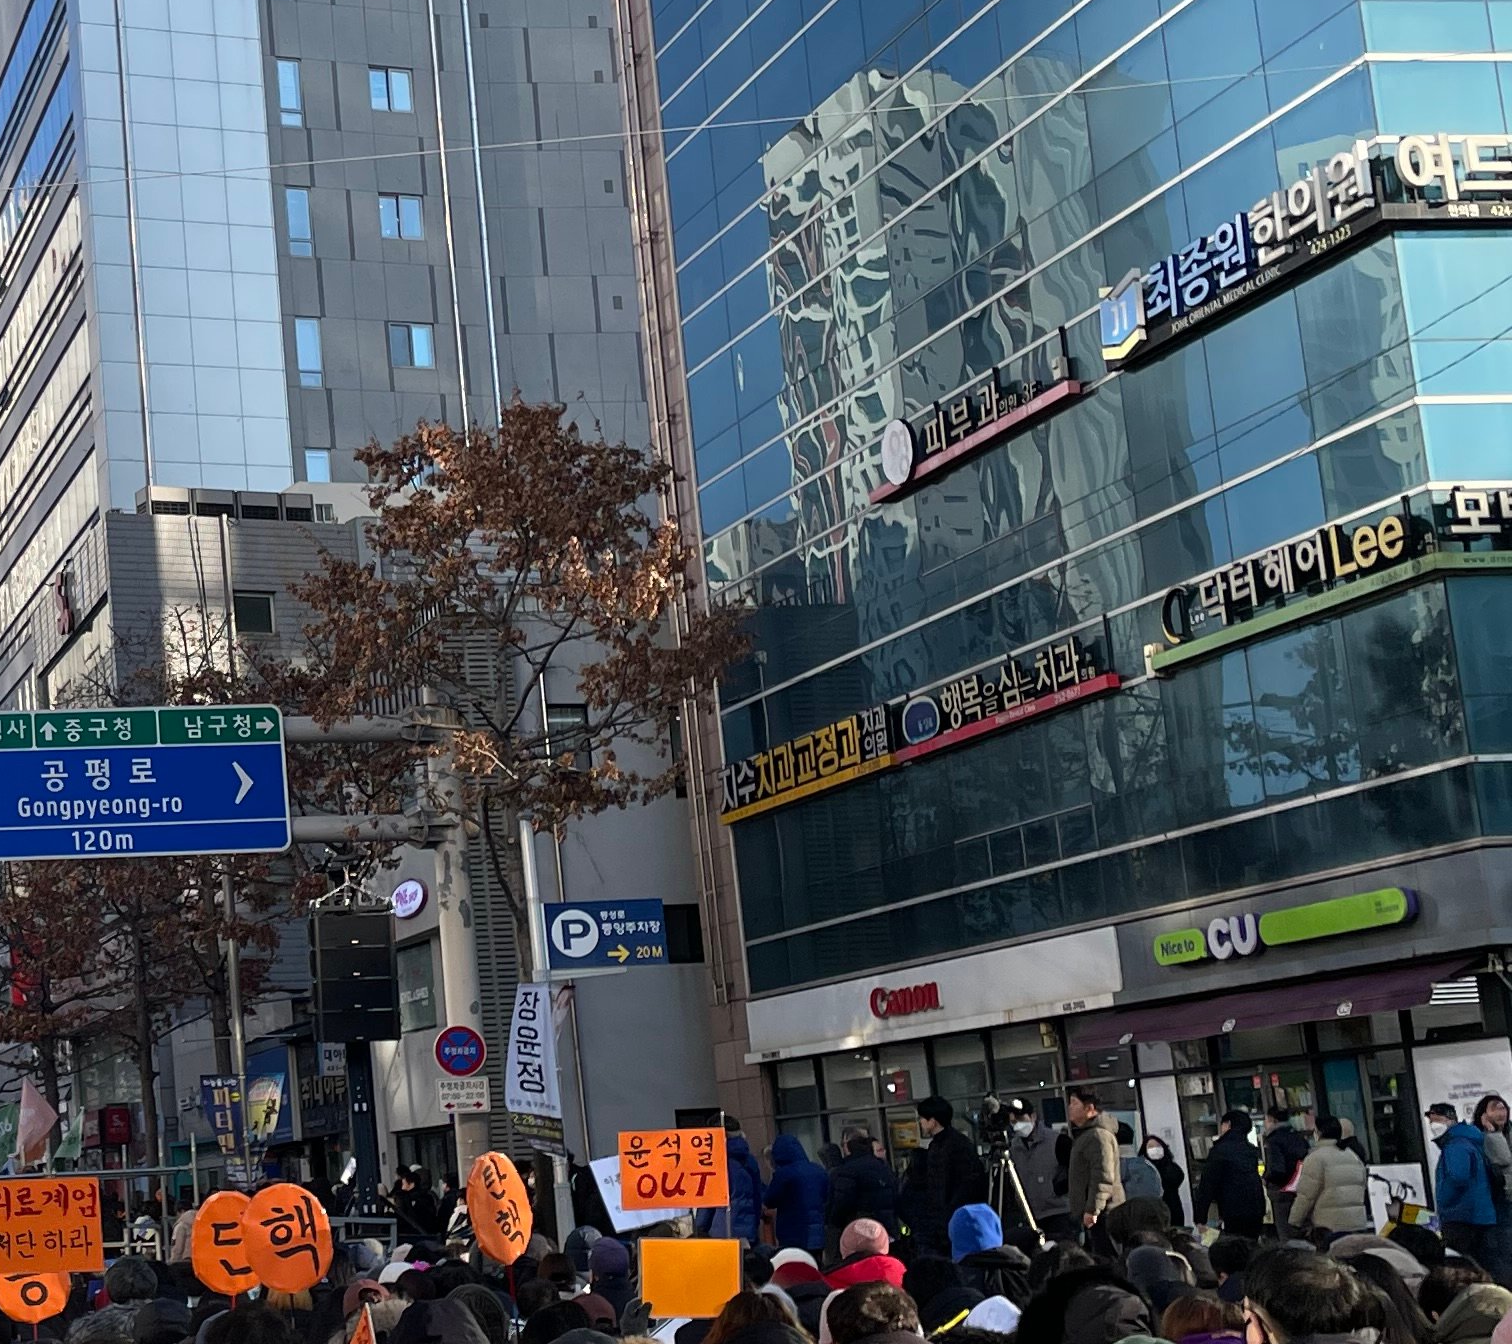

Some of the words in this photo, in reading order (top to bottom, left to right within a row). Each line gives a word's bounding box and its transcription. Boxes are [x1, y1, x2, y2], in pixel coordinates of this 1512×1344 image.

[1223, 280, 1255, 306] MEDICAL
[1255, 264, 1282, 287] CLINIC
[925, 380, 999, 454] 피부과
[63, 717, 132, 741] 중구청
[184, 714, 251, 739] 남구청
[41, 758, 157, 792] 공평로
[18, 796, 183, 821] Gongpyeong-ro
[71, 830, 134, 852] 120m
[601, 920, 661, 935] 중앙주차장
[1160, 941, 1182, 958] Nice
[1184, 939, 1195, 954] to
[1207, 912, 1257, 960] CU
[870, 981, 940, 1019] Canon
[516, 991, 546, 1094] 장윤정
[623, 1132, 713, 1168] 윤석열
[260, 1195, 320, 1278] 핵
